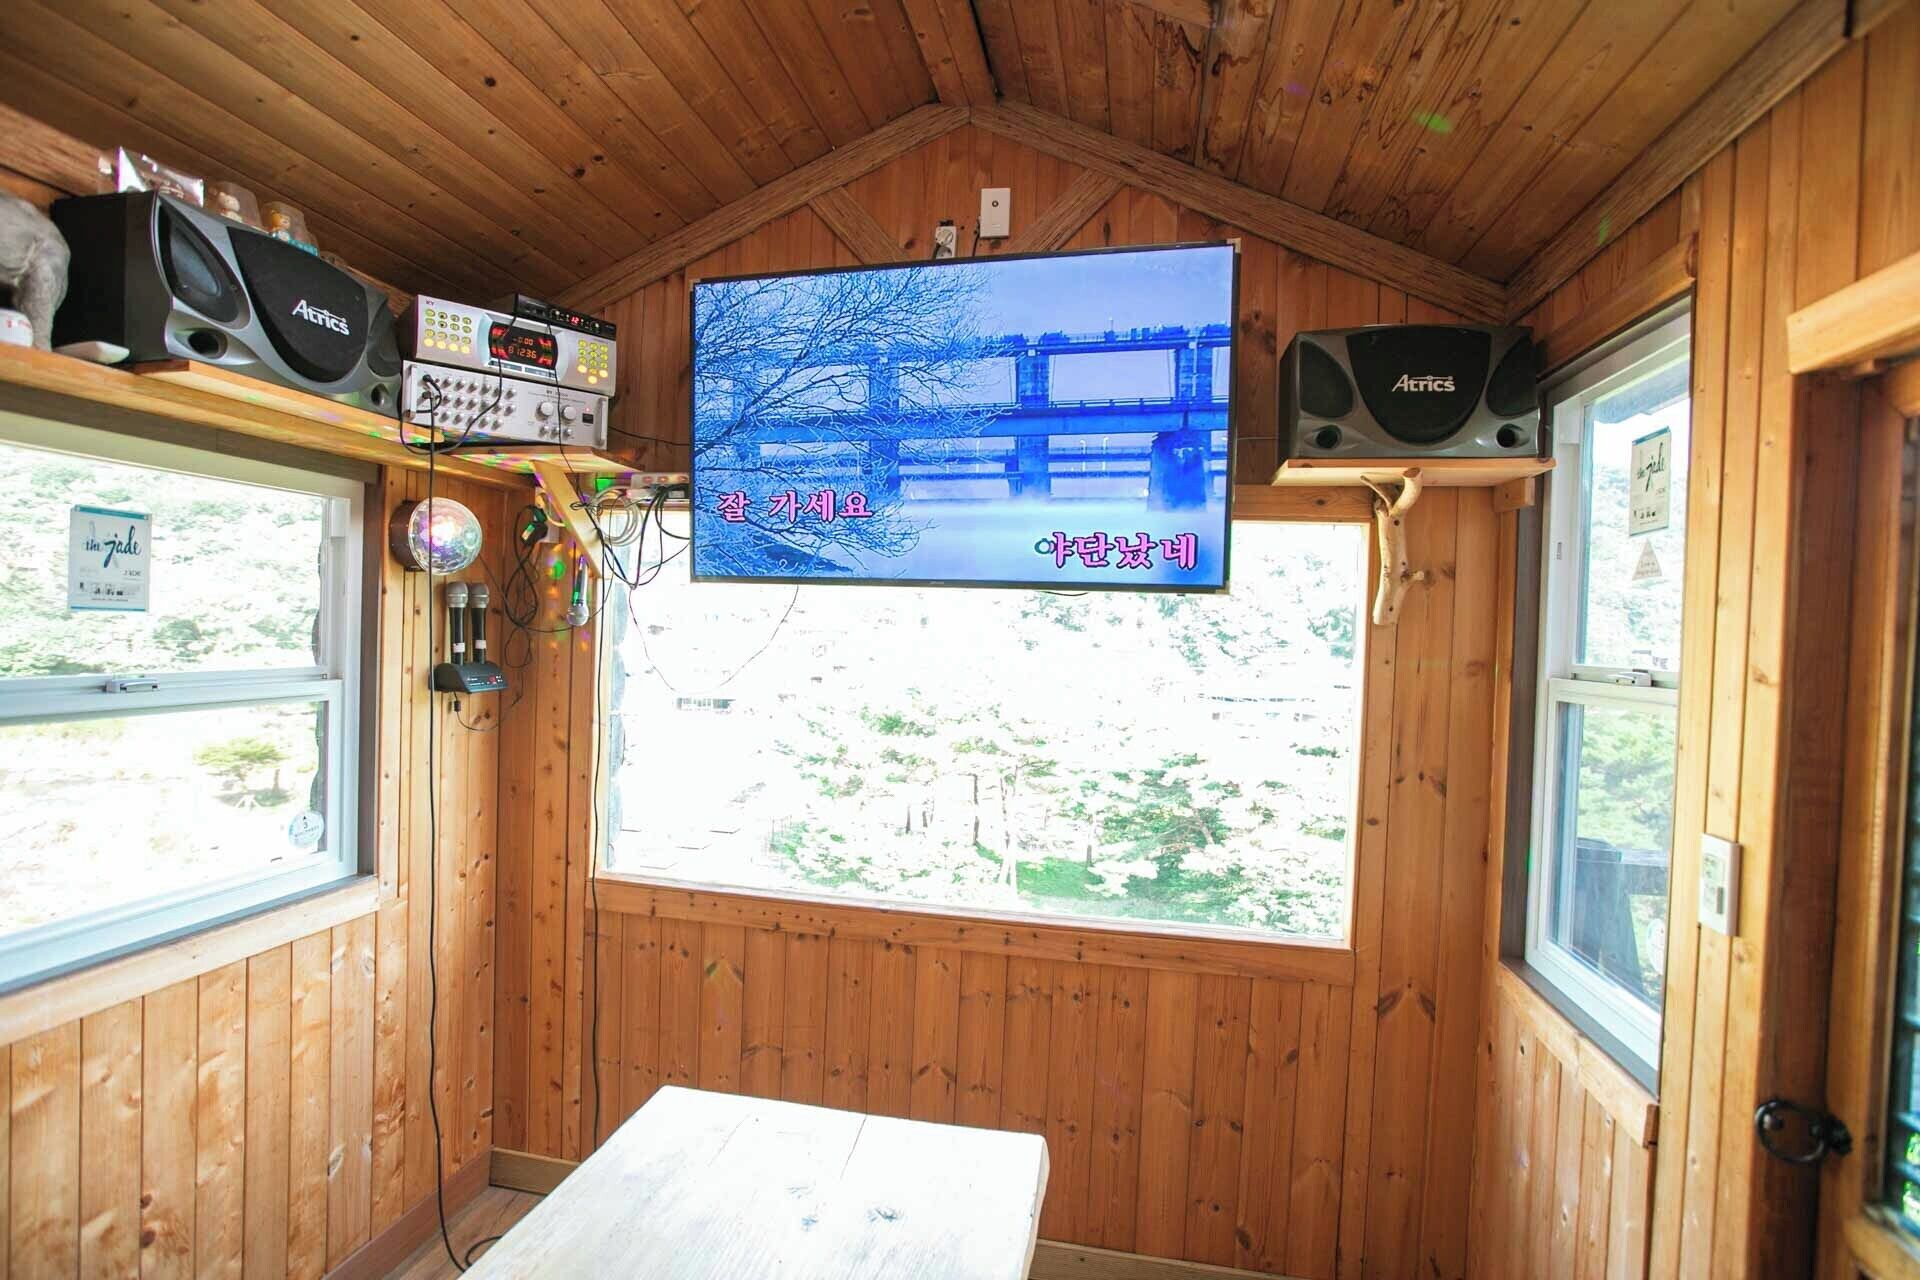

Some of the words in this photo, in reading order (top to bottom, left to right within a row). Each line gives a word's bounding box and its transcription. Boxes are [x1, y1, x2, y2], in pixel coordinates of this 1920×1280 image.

[292, 299, 350, 335] Atrics
[1391, 374, 1456, 392] Atrics
[717, 490, 752, 524] 잘
[768, 488, 875, 524] 가세요
[85, 538, 101, 552] the
[103, 525, 142, 568] jade
[1034, 531, 1199, 571] 야단났네
